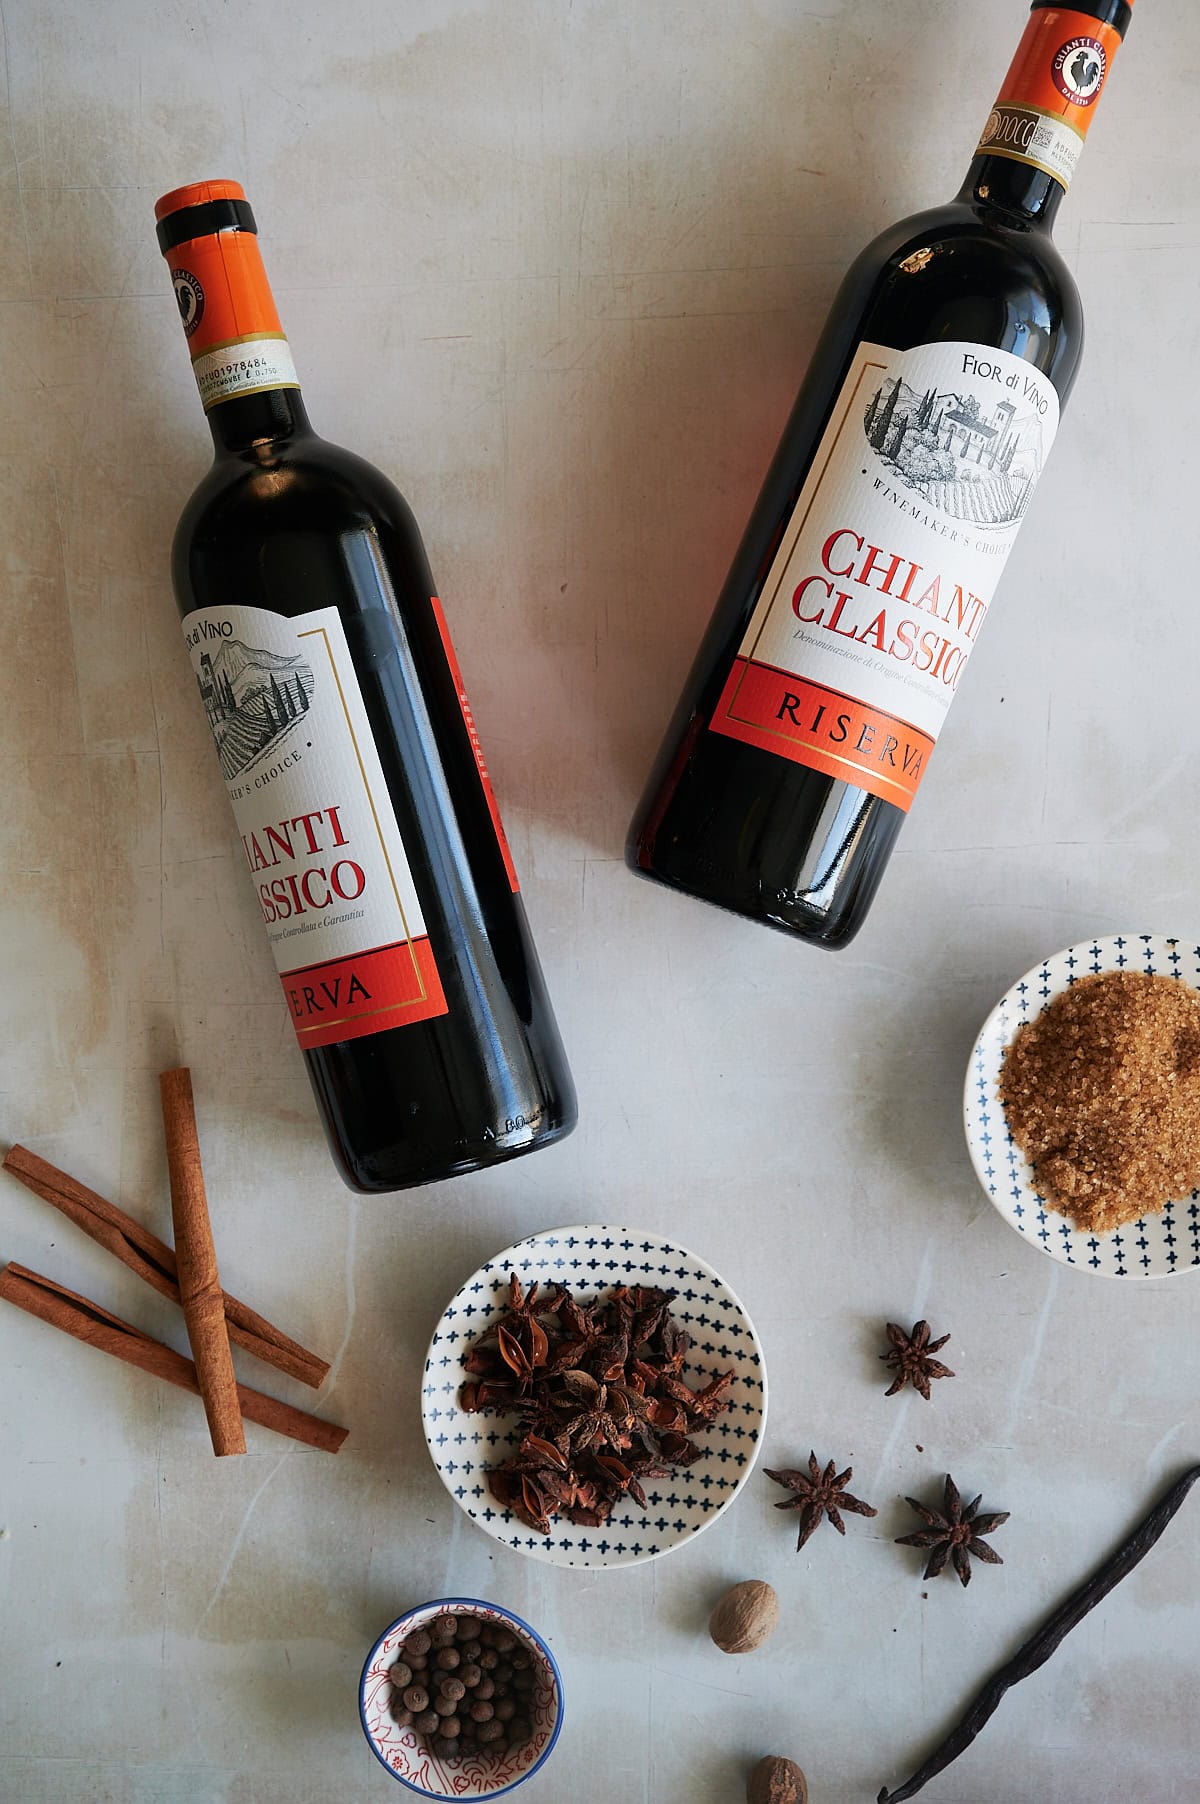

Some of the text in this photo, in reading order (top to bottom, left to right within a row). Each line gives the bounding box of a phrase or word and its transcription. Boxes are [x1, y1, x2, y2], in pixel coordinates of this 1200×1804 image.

[1054, 38, 1091, 70] CHIANTI
[1061, 87, 1075, 101] DAL
[962, 353, 1049, 415] FIOR di VINO
[872, 477, 970, 547] WINEMAKER'S
[193, 627, 201, 644] di
[198, 620, 233, 641] VINO
[792, 629, 863, 665] Denominazione
[776, 692, 923, 781] RISERVA
[254, 750, 302, 789] CHOICE
[256, 859, 366, 924] SSICO
[323, 908, 365, 928] Garantita
[289, 973, 372, 1017] ERVA
